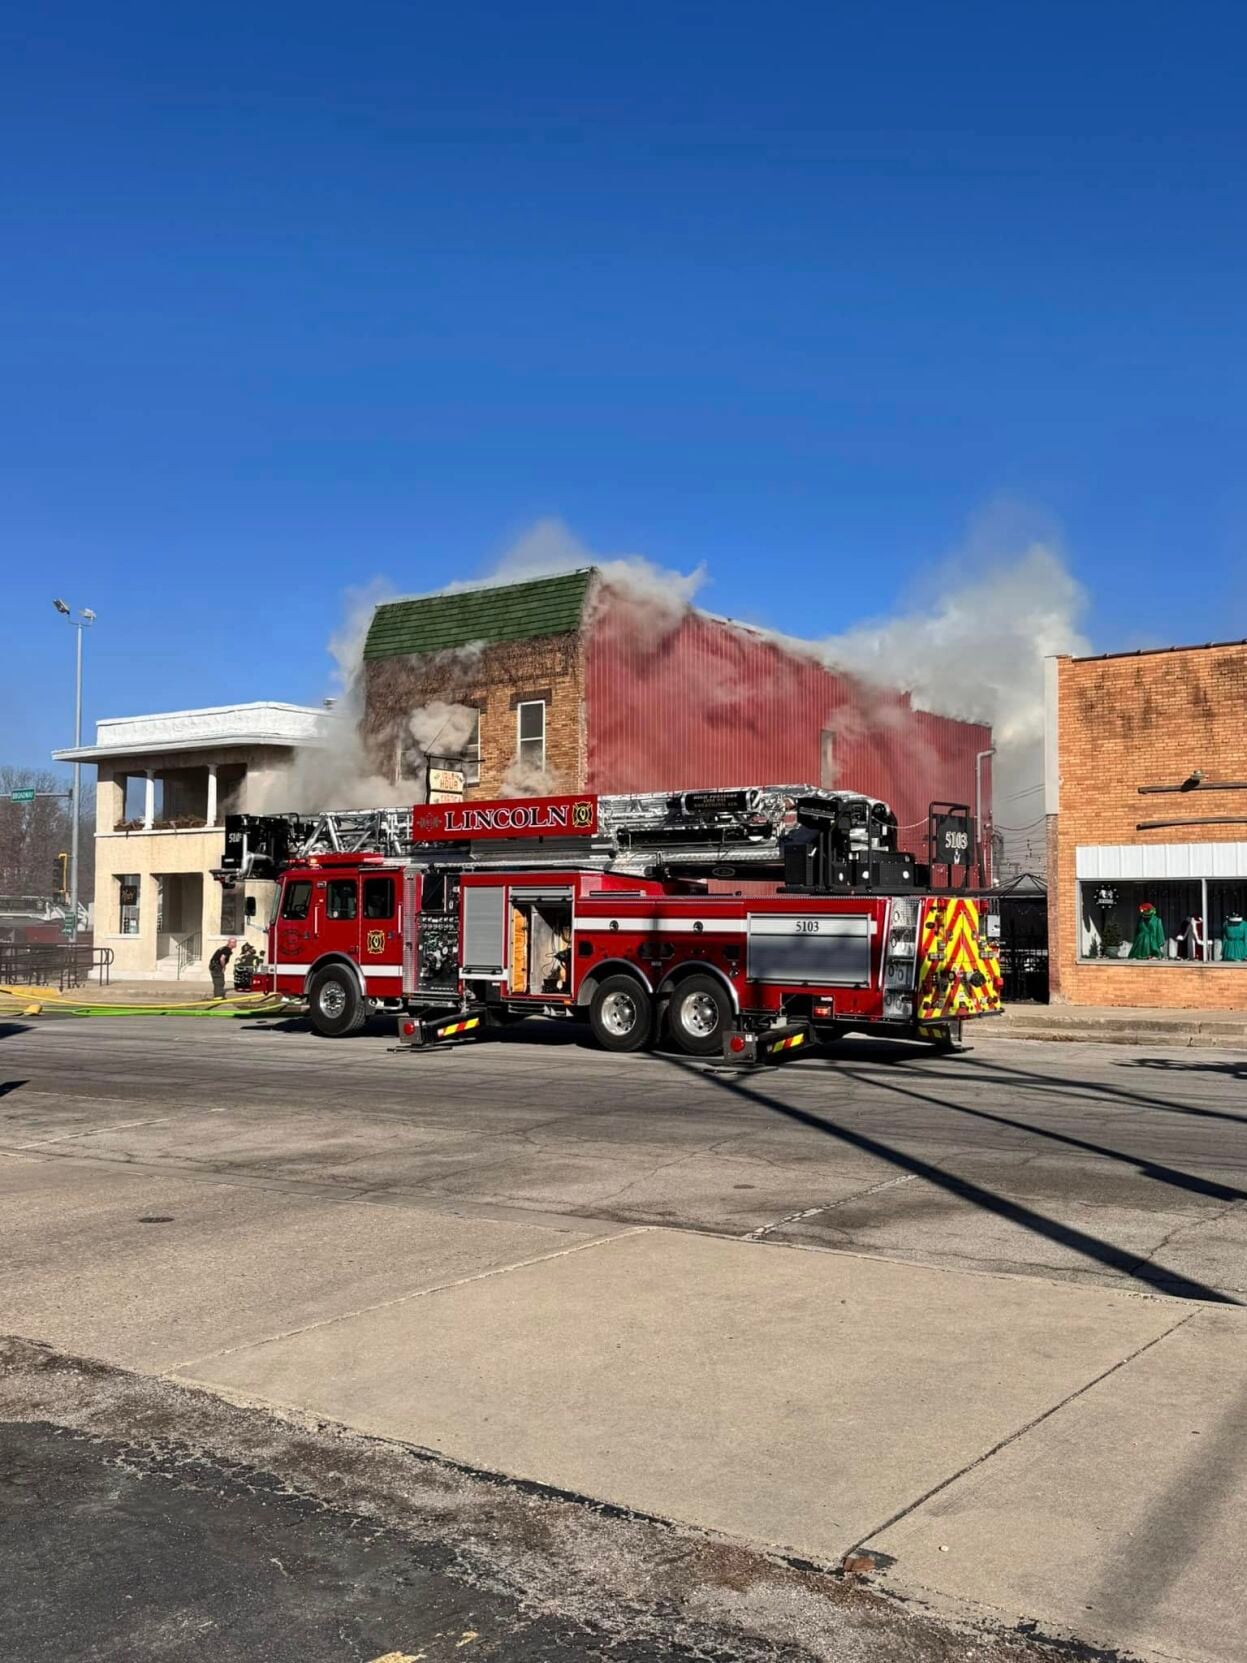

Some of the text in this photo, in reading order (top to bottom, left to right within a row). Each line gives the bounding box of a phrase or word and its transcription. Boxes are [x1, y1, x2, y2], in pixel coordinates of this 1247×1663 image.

[444, 804, 569, 832] LINCOLN
[228, 832, 243, 843] 510
[945, 831, 968, 850] 5103
[795, 920, 820, 932] 5103
